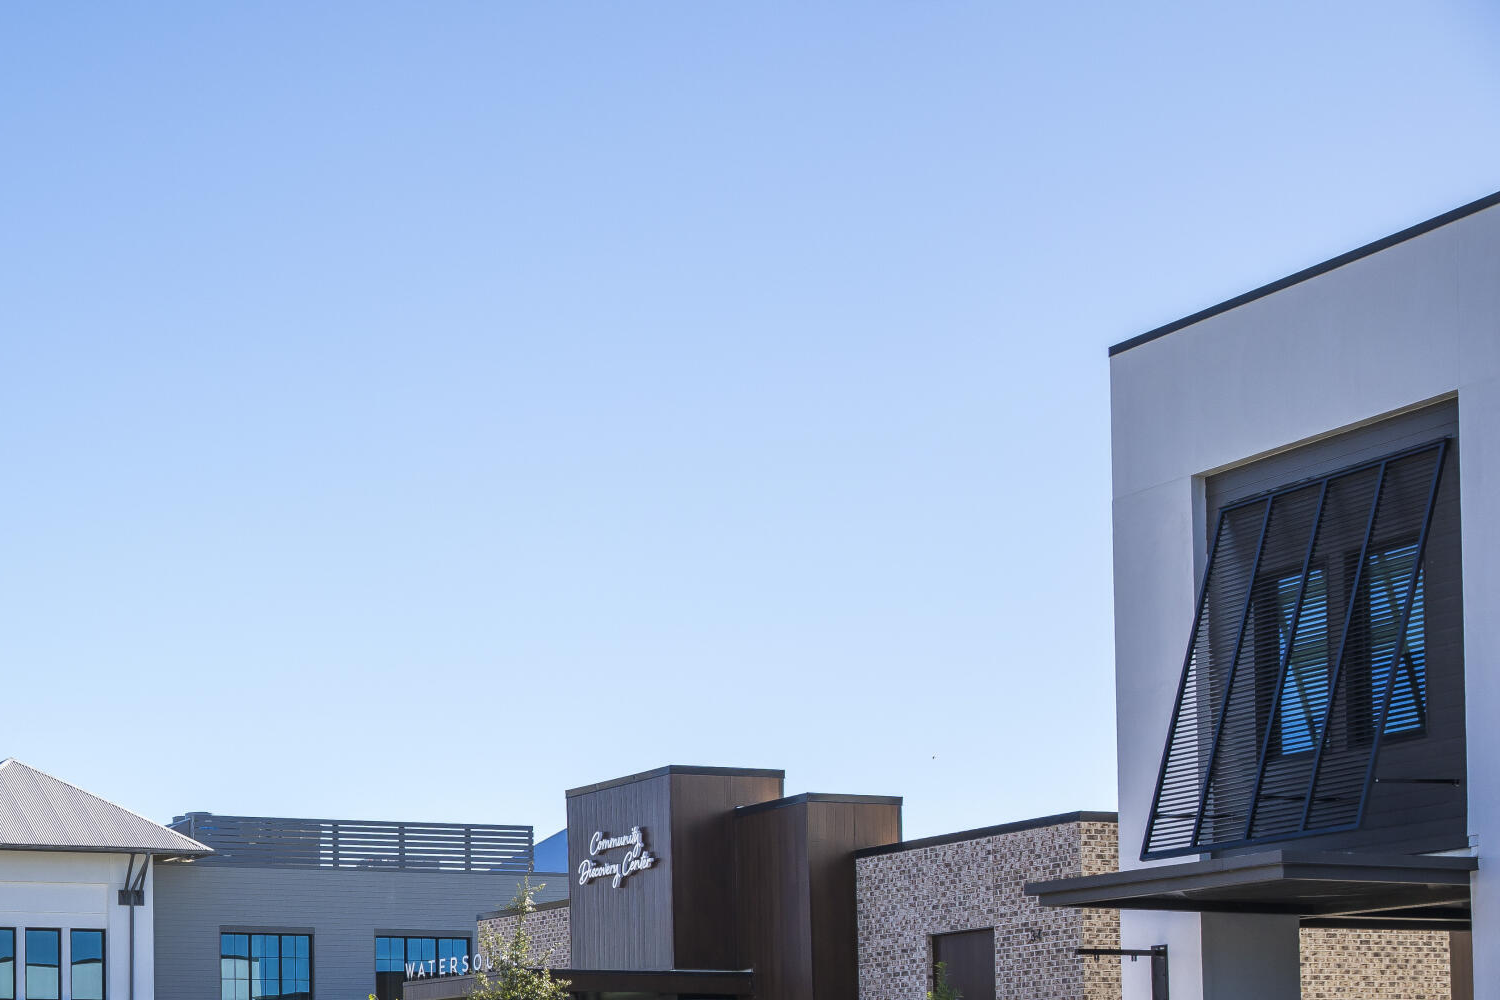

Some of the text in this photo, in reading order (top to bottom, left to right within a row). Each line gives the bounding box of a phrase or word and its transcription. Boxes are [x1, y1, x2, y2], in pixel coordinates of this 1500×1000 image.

[589, 826, 644, 857] Community
[578, 851, 655, 889] Discovery Center
